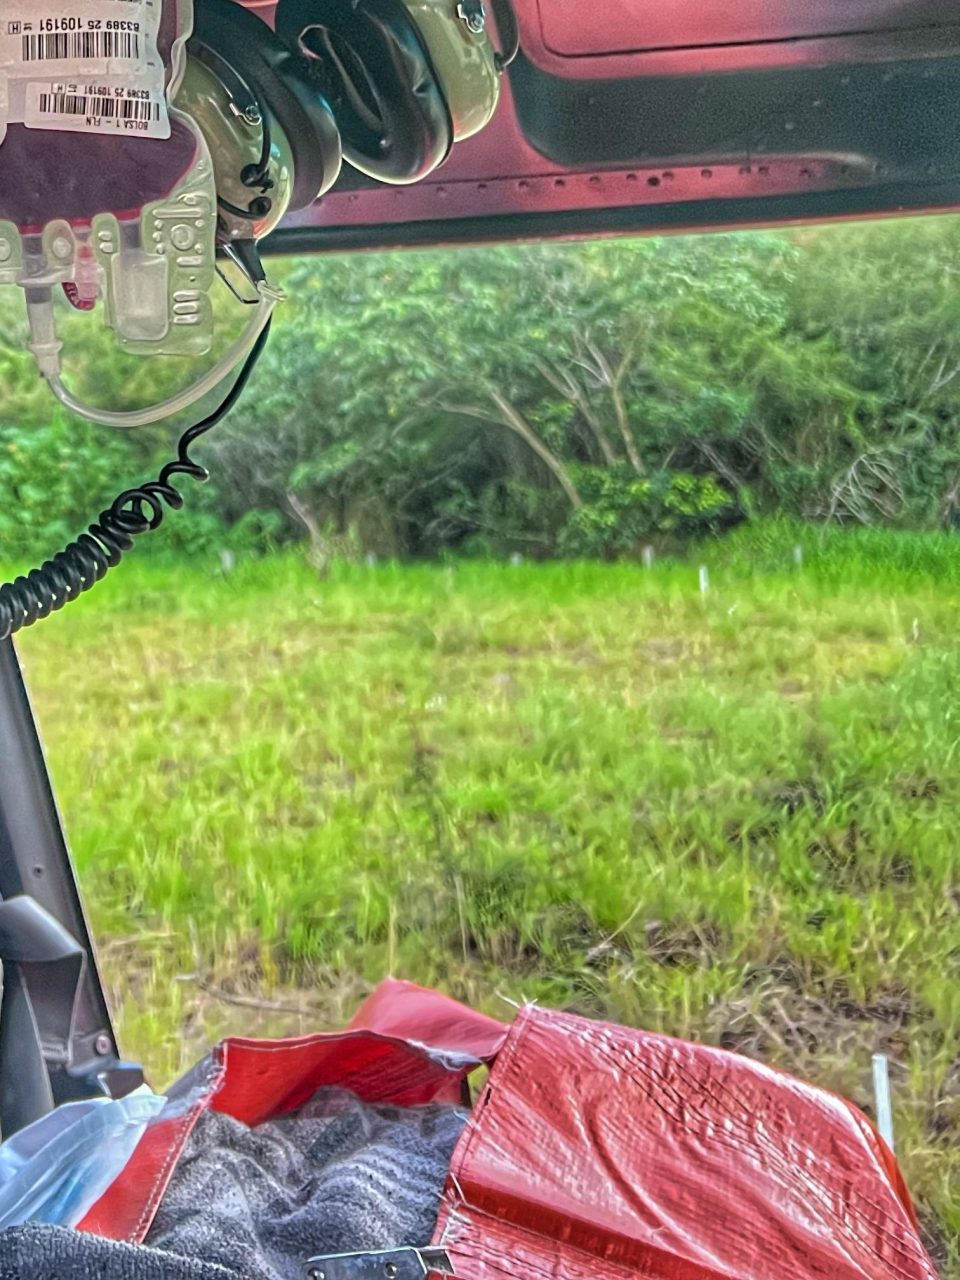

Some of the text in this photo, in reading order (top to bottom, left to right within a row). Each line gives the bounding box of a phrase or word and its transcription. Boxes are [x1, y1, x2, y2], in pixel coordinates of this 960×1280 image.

[40, 17, 82, 31] 109191
[88, 20, 101, 30] 25
[114, 87, 124, 97] 25
[86, 117, 101, 126] FLN
[124, 120, 148, 130] BOLSA
